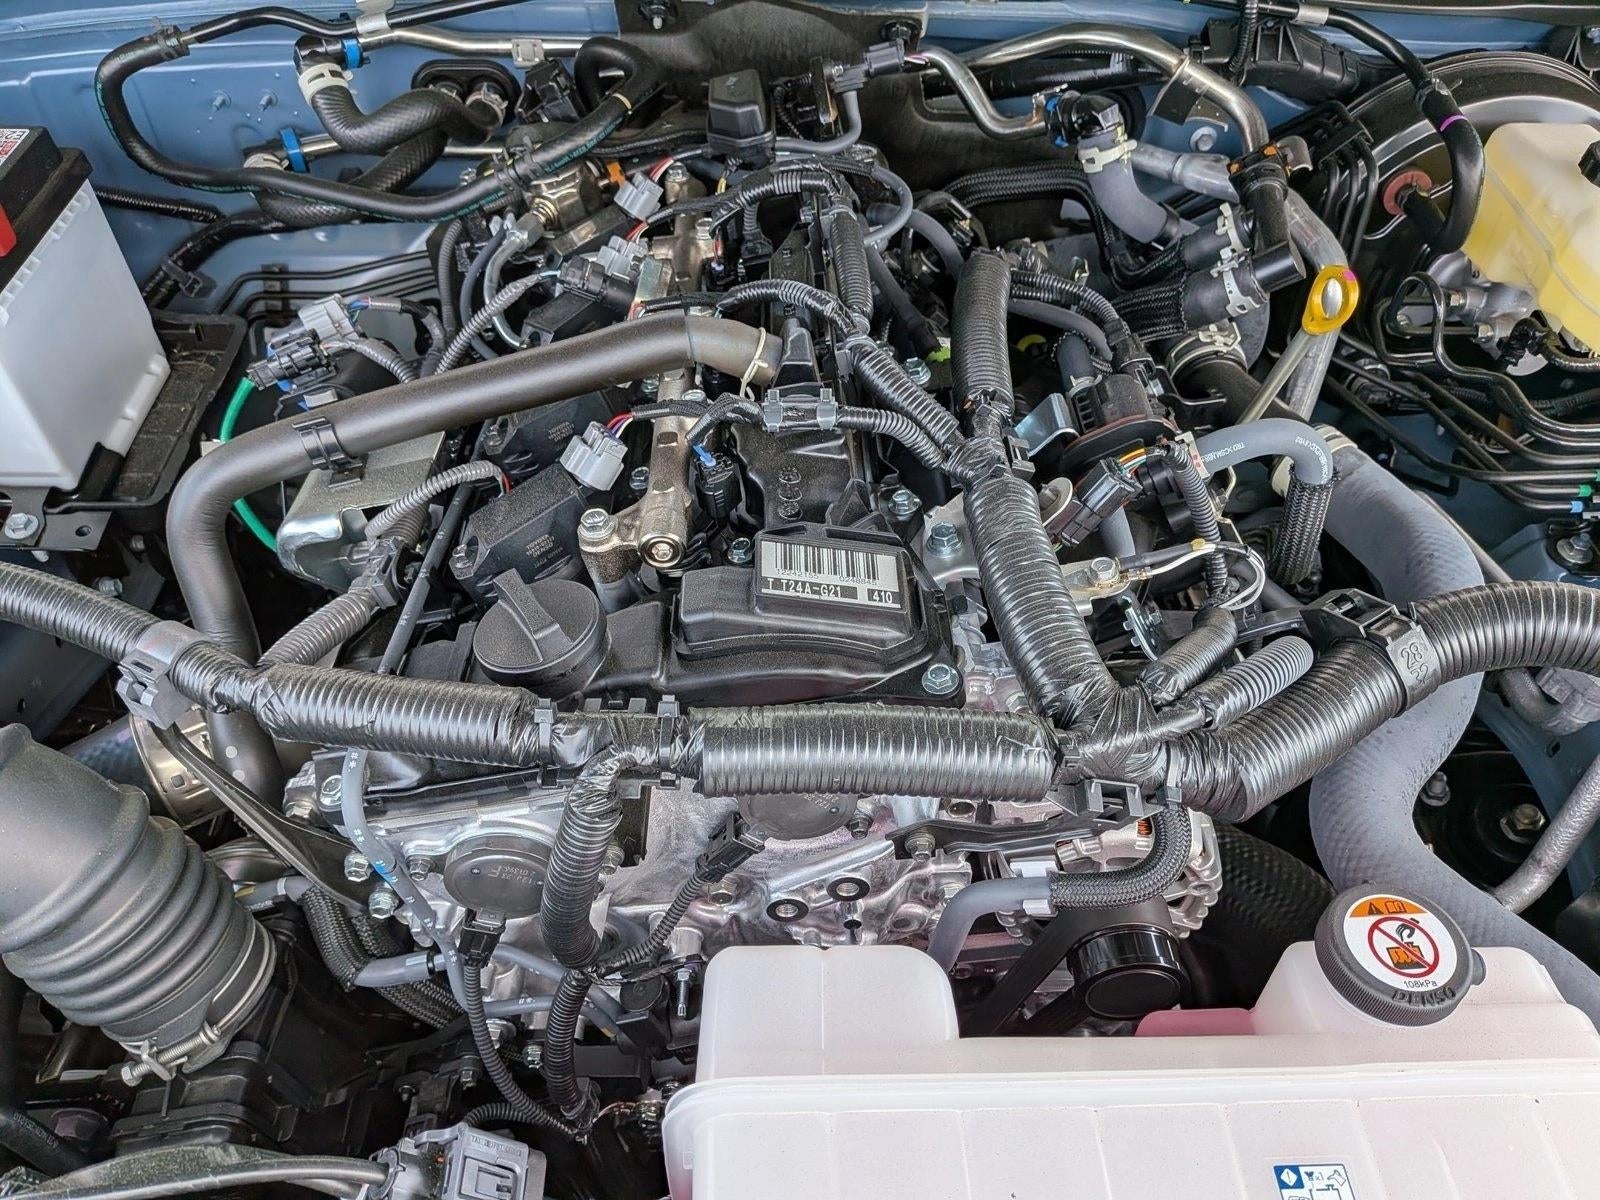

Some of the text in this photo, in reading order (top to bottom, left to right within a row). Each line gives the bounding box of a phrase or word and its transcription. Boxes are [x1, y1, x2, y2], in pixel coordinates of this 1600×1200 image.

[526, 534, 549, 549] TOYOTA
[767, 578, 893, 604] T T24A-G21 410
[1401, 642, 1423, 670] 28
[1403, 980, 1437, 988] 108kPa
[1391, 986, 1456, 1007] DENSO
